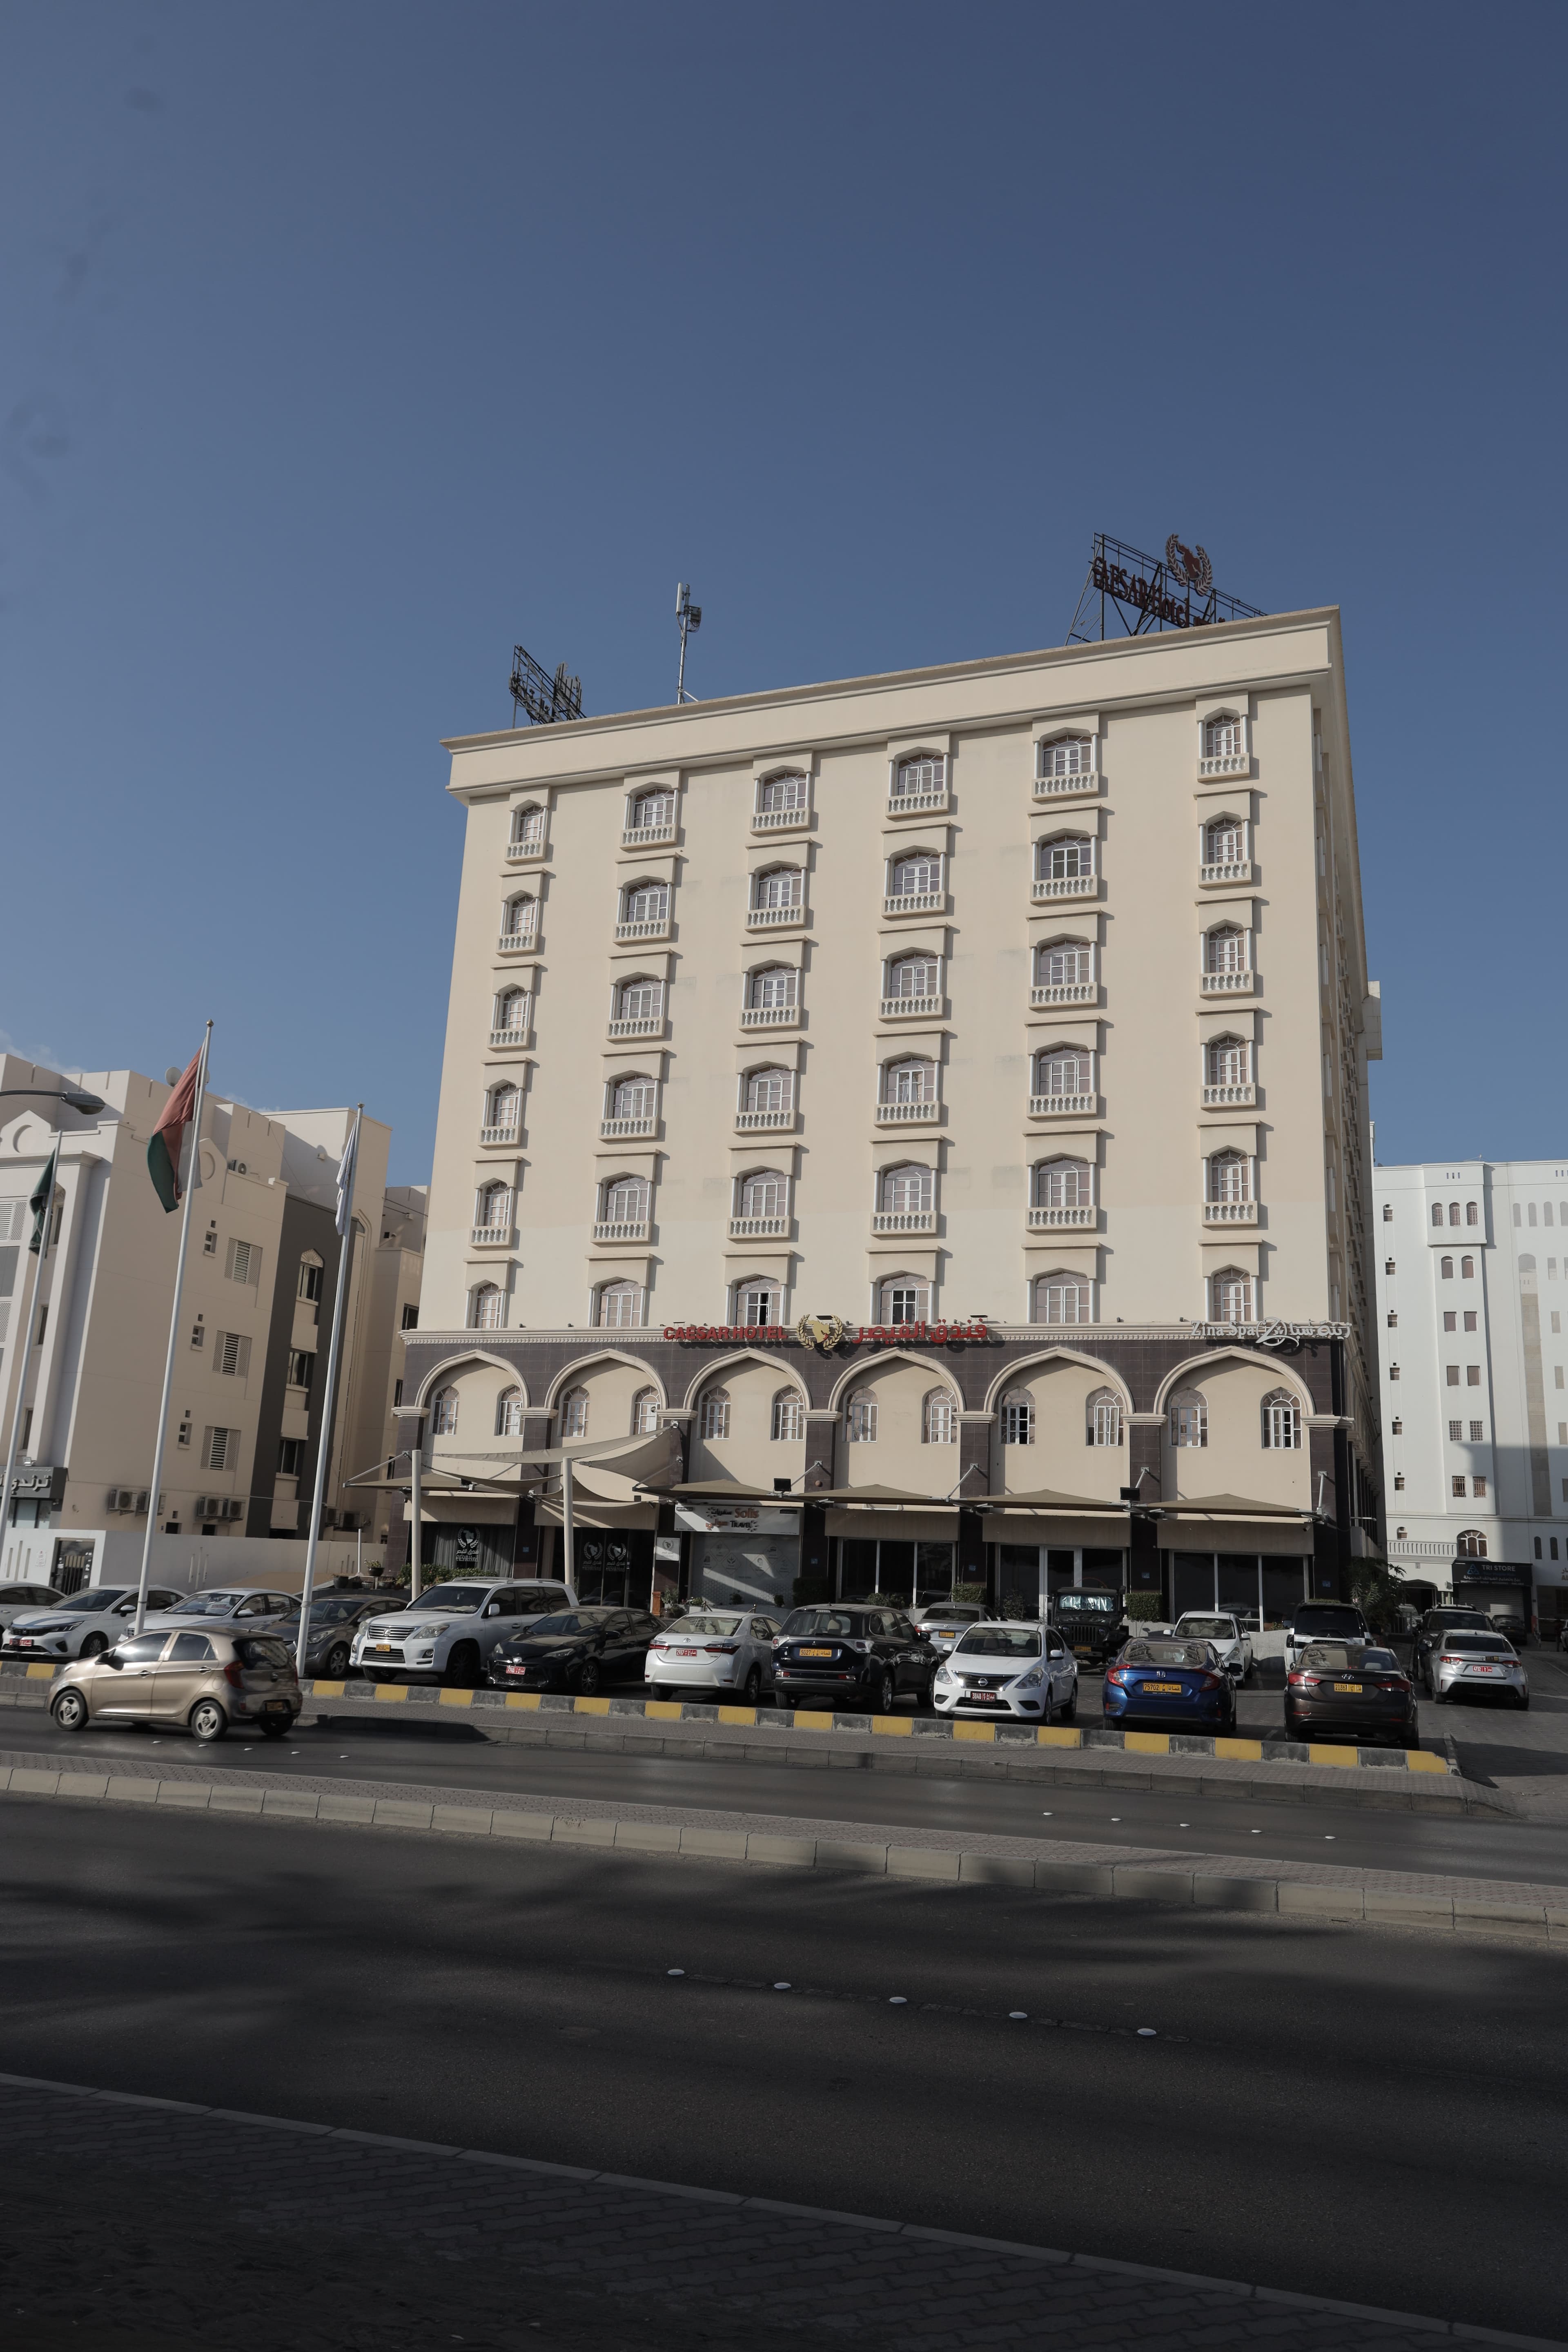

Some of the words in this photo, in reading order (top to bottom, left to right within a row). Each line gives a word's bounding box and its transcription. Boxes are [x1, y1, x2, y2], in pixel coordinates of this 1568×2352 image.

[1093, 557, 1148, 611] CAESAR
[1149, 583, 1189, 628] Hotel
[664, 1326, 729, 1340] CAESAR
[733, 1325, 788, 1339] HOTEL
[852, 1319, 926, 1345] القيصر
[930, 1318, 987, 1343] فندق
[1191, 1321, 1225, 1336] Zina
[1228, 1320, 1256, 1339] Spa
[734, 1507, 760, 1519] Solis
